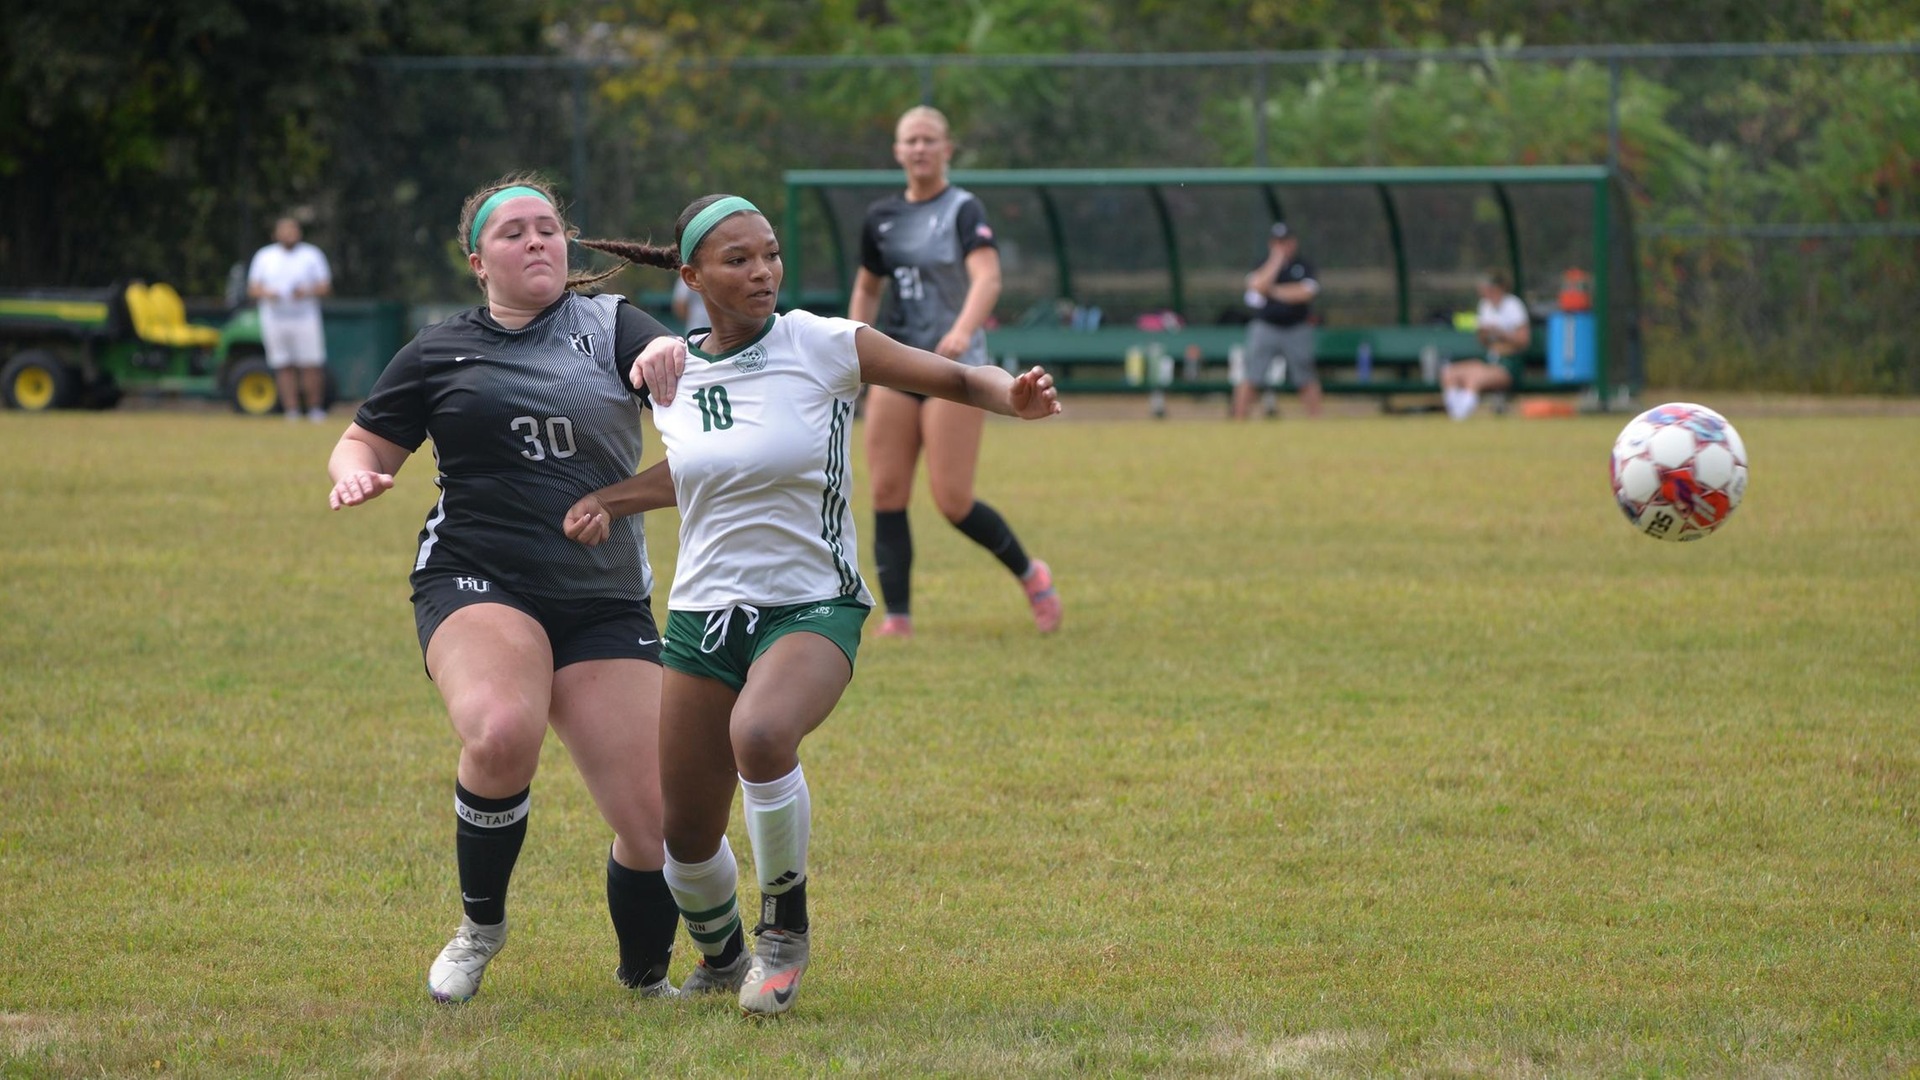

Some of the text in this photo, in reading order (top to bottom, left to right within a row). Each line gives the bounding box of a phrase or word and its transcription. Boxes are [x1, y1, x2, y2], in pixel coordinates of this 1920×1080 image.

[894, 266, 924, 301] 21
[692, 375, 733, 432] 10
[510, 416, 577, 461] 30
[459, 804, 515, 825] CAPTAIN
